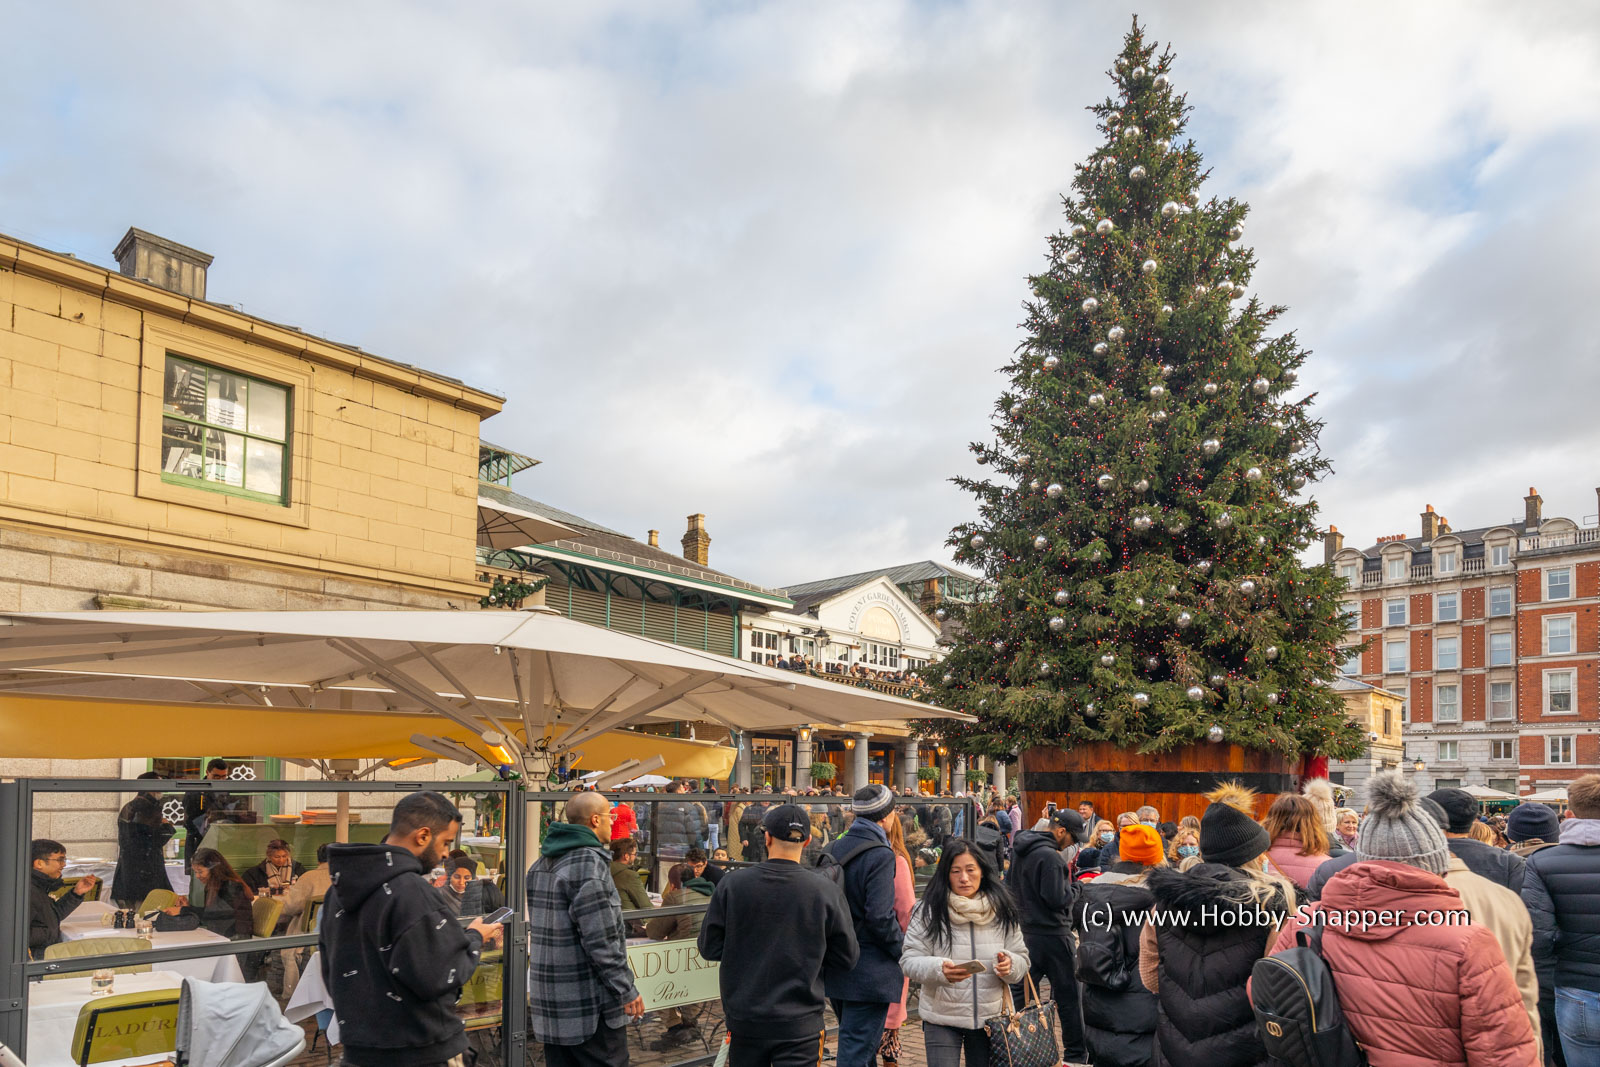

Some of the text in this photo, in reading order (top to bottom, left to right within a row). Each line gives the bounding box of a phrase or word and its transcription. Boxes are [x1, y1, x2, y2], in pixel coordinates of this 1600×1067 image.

[849, 596, 866, 630] COVENT
[867, 592, 895, 606] GARDEN
[895, 604, 910, 640] MARKET
[653, 981, 689, 1002] Paris
